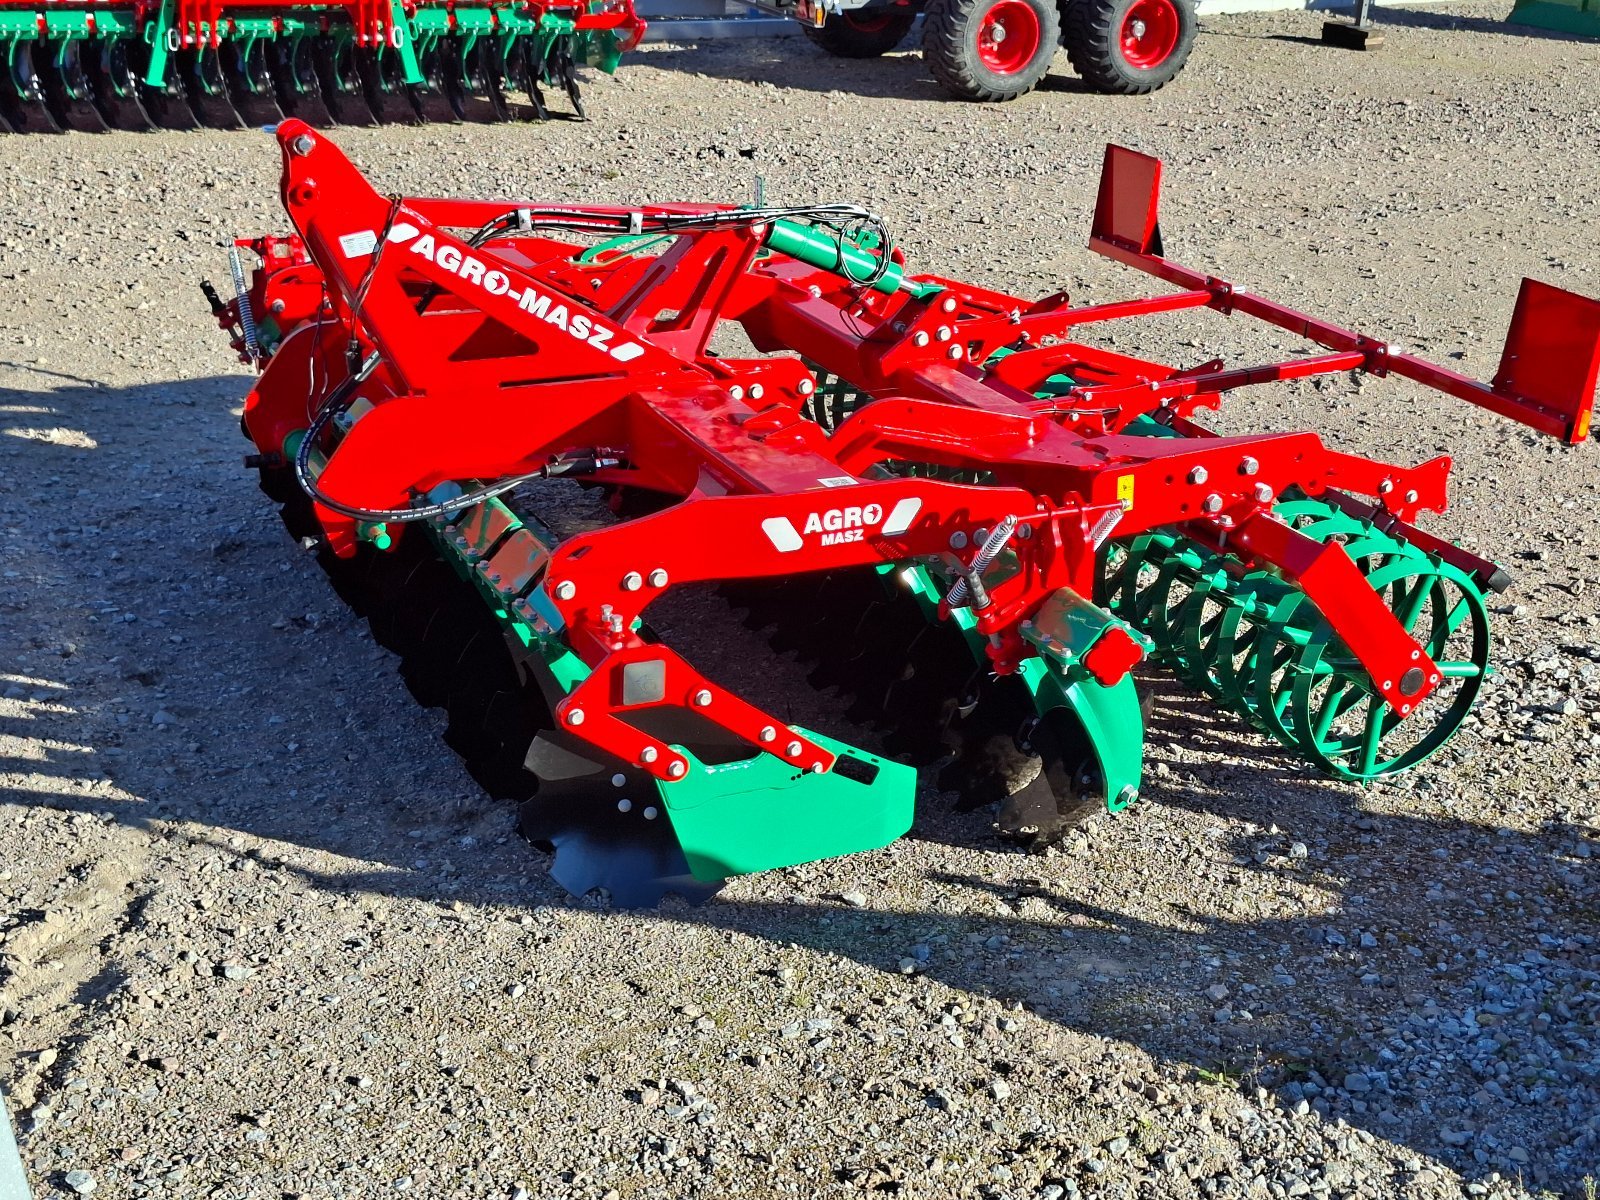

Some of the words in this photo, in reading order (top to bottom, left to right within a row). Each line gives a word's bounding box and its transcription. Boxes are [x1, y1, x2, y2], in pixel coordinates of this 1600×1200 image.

[410, 234, 615, 352] AGRO-MASZ
[804, 503, 883, 534] AGRO
[821, 529, 864, 546] MASZ
